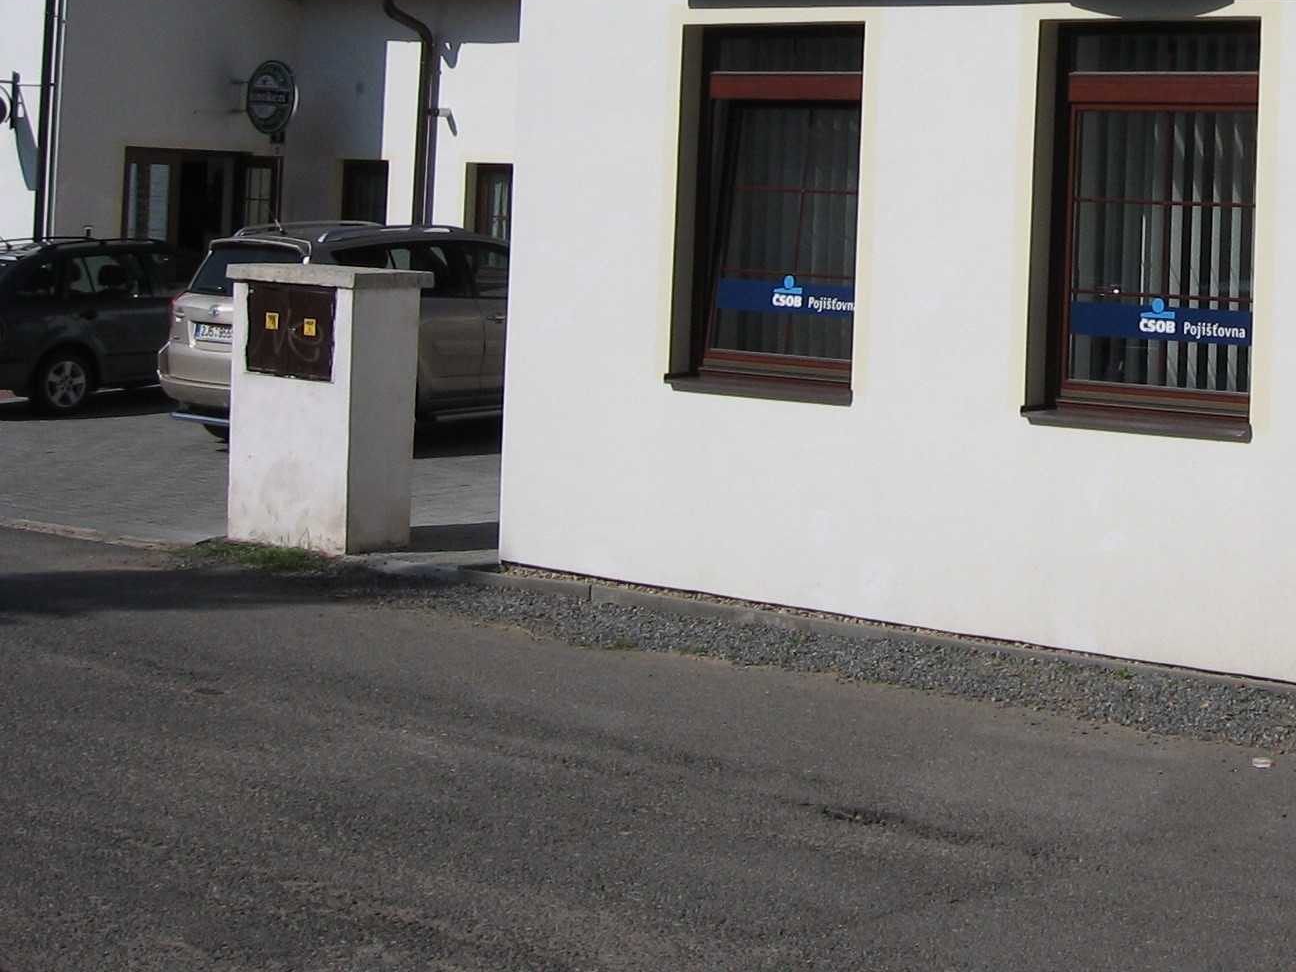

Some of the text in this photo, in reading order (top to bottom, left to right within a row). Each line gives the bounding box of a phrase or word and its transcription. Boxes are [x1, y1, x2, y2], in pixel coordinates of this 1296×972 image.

[772, 293, 802, 307] ČSOB
[1139, 318, 1246, 339] ČSOB Pojišťovna
